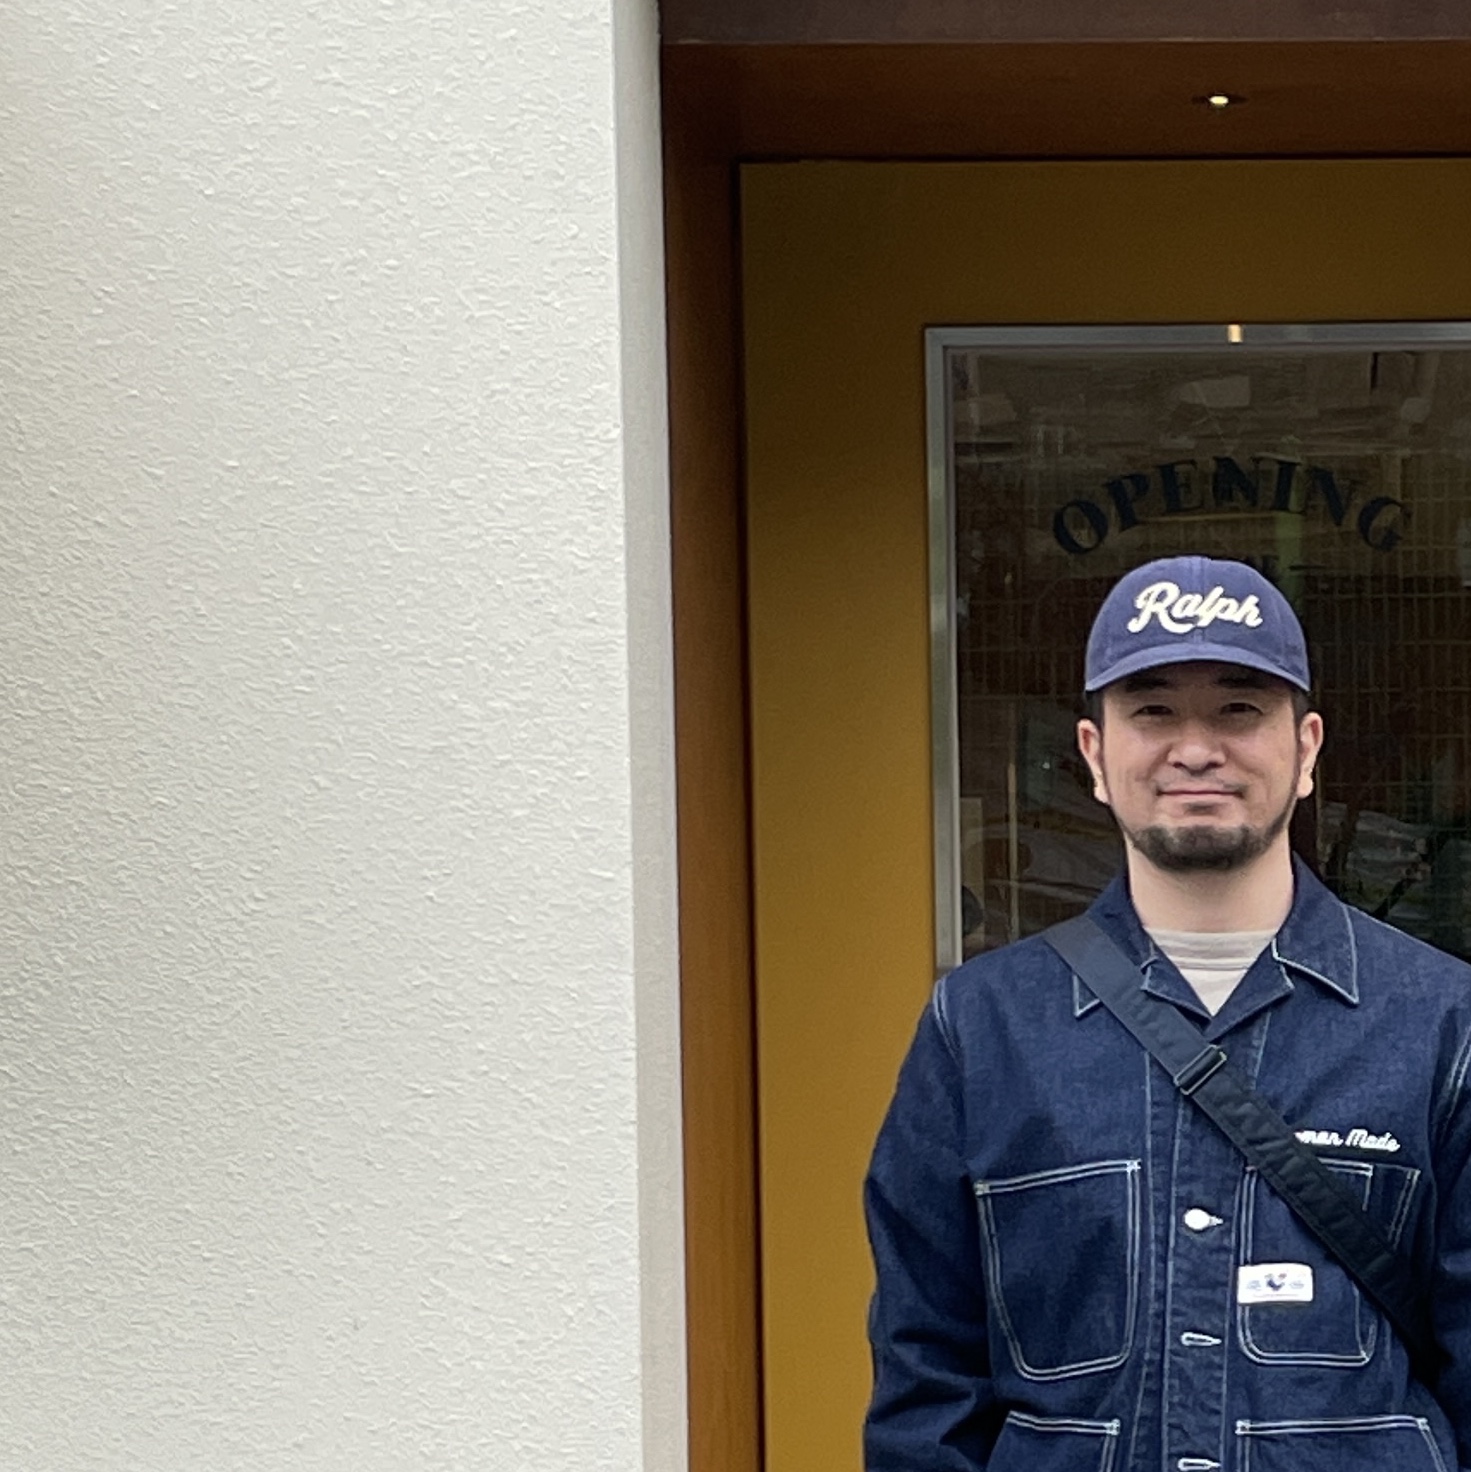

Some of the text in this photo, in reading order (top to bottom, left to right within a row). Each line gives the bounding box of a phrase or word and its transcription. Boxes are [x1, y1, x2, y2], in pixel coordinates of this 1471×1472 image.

[1053, 456, 1411, 555] OPENING
[1127, 581, 1263, 634] Ralph
[1293, 1128, 1401, 1152] man Made
